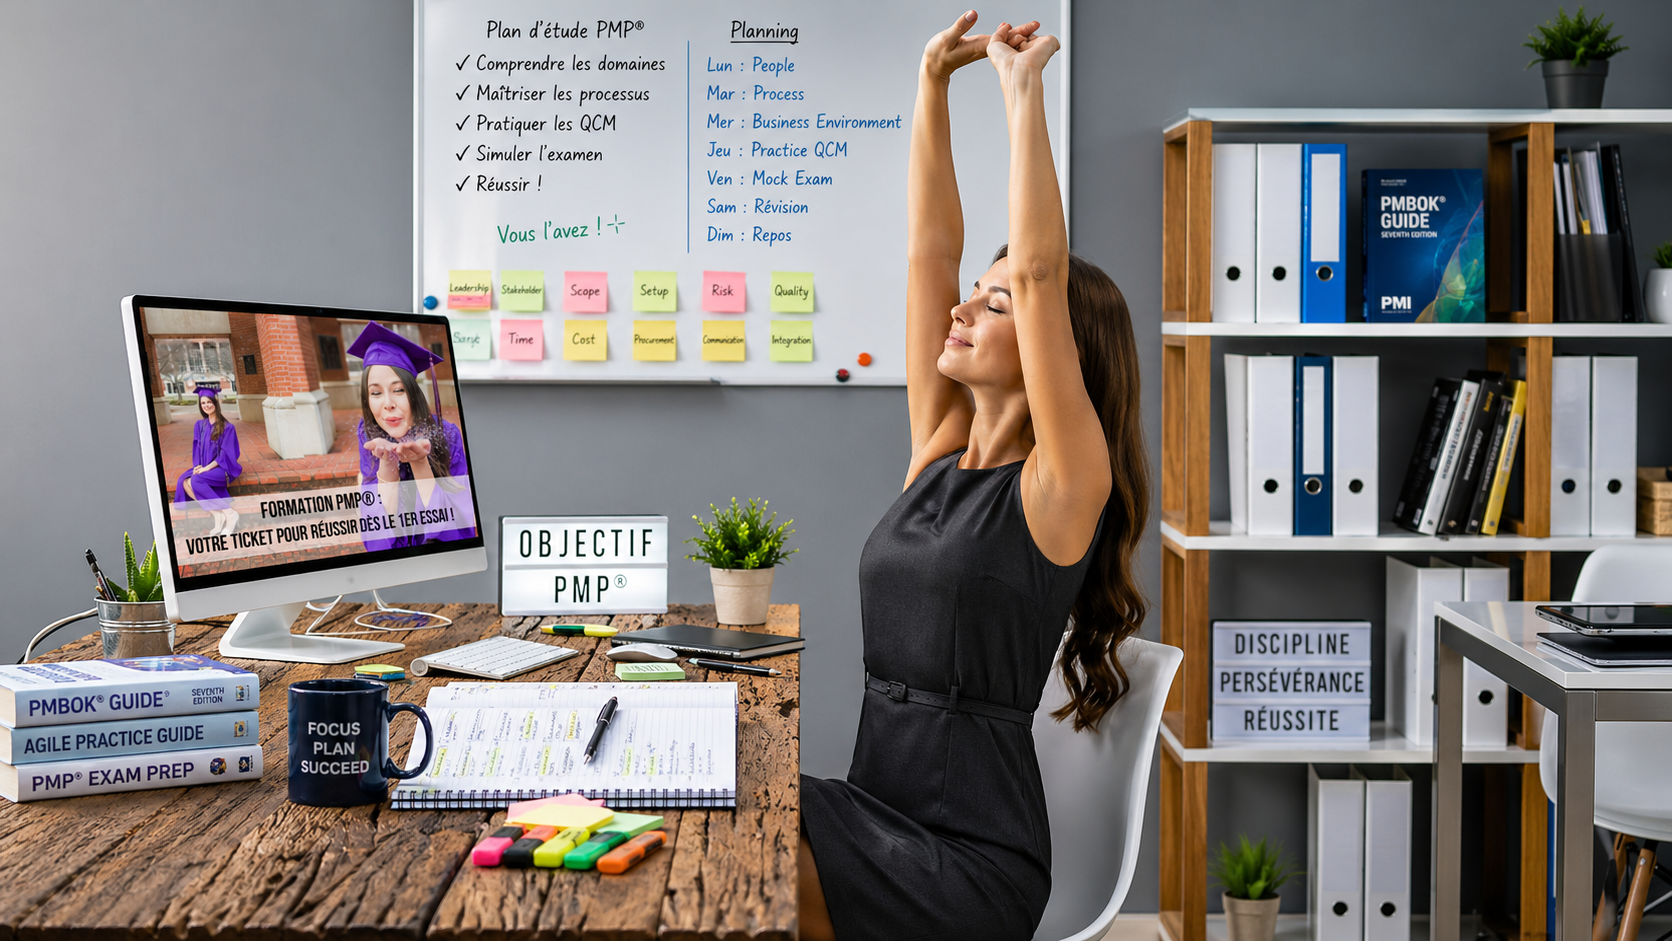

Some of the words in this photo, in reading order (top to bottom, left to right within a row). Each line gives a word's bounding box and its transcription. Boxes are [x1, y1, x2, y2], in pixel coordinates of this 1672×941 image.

[487, 20, 521, 38] Plan
[530, 20, 588, 38] d’étude
[597, 20, 644, 38] PMP®
[731, 20, 799, 44] Planning
[476, 54, 565, 76] Comprendre
[572, 54, 591, 70] les
[598, 55, 666, 70] domaines
[707, 57, 732, 72] Lun
[753, 57, 795, 77] People
[477, 84, 546, 100] Maîtriser
[554, 84, 572, 100] les
[580, 88, 650, 106] processus
[707, 85, 735, 100] Mar
[754, 85, 804, 100] Process
[477, 114, 547, 137] Pratiquer
[554, 115, 573, 130] les
[580, 114, 616, 132] QCM
[707, 113, 734, 128] Mer
[753, 113, 809, 128] Business
[816, 113, 902, 128] Environment
[476, 145, 532, 161] Simuler
[539, 145, 603, 161] l’examen
[707, 142, 731, 157] Jeu
[751, 141, 808, 157] Practice
[814, 142, 848, 158] QCM
[476, 175, 530, 191] Réussir
[707, 170, 732, 185] Ven
[752, 170, 788, 185] Mock
[795, 170, 833, 185] Exam
[707, 198, 736, 213] Sam
[754, 198, 808, 213] Révision
[1380, 196, 1446, 212] PMBOK®
[1380, 213, 1430, 228] GUIDE
[497, 225, 536, 243] Vous
[544, 221, 588, 240] l’avez
[707, 226, 734, 241] Dim
[753, 226, 792, 247] Repos
[449, 283, 489, 295] Leadership
[501, 284, 542, 294] Stakeholder
[570, 284, 600, 299] Scope
[640, 284, 669, 299] Setup
[712, 284, 733, 296] Risk
[774, 284, 809, 300] Quality
[1381, 296, 1412, 309] PMI
[508, 332, 534, 345] Time
[572, 333, 596, 345] Cost
[634, 334, 675, 344] Procurement
[702, 335, 744, 344] Communication
[772, 335, 811, 348] Integration
[260, 495, 334, 518] FORMATION
[336, 491, 375, 510] PMP®
[186, 534, 229, 555] VOTRE
[230, 529, 273, 549] TICKET
[276, 525, 308, 543] POUR
[311, 518, 359, 540] RÉUSSIR
[360, 515, 381, 532] DÈS
[382, 515, 396, 529] LE
[398, 512, 419, 527] 1ER
[419, 508, 449, 525] ESSAI
[519, 529, 653, 558] OBJECTIF
[555, 574, 627, 603] PMP®
[1235, 633, 1349, 654] DISCIPLINE
[1220, 668, 1364, 692] PERSÉVÉRANCE
[191, 687, 224, 696] SEVENTH
[193, 696, 223, 705] EDITION
[1244, 706, 1339, 730] RÉUSSITE
[308, 722, 360, 736] FOCUS
[24, 735, 71, 754] AGILE
[76, 729, 153, 750] PRACTICE
[157, 725, 204, 743] GUIDE
[313, 742, 355, 755] PLAN
[88, 767, 141, 786] EXAM
[147, 762, 194, 781] PREP
[301, 760, 369, 774] SUCCEED
